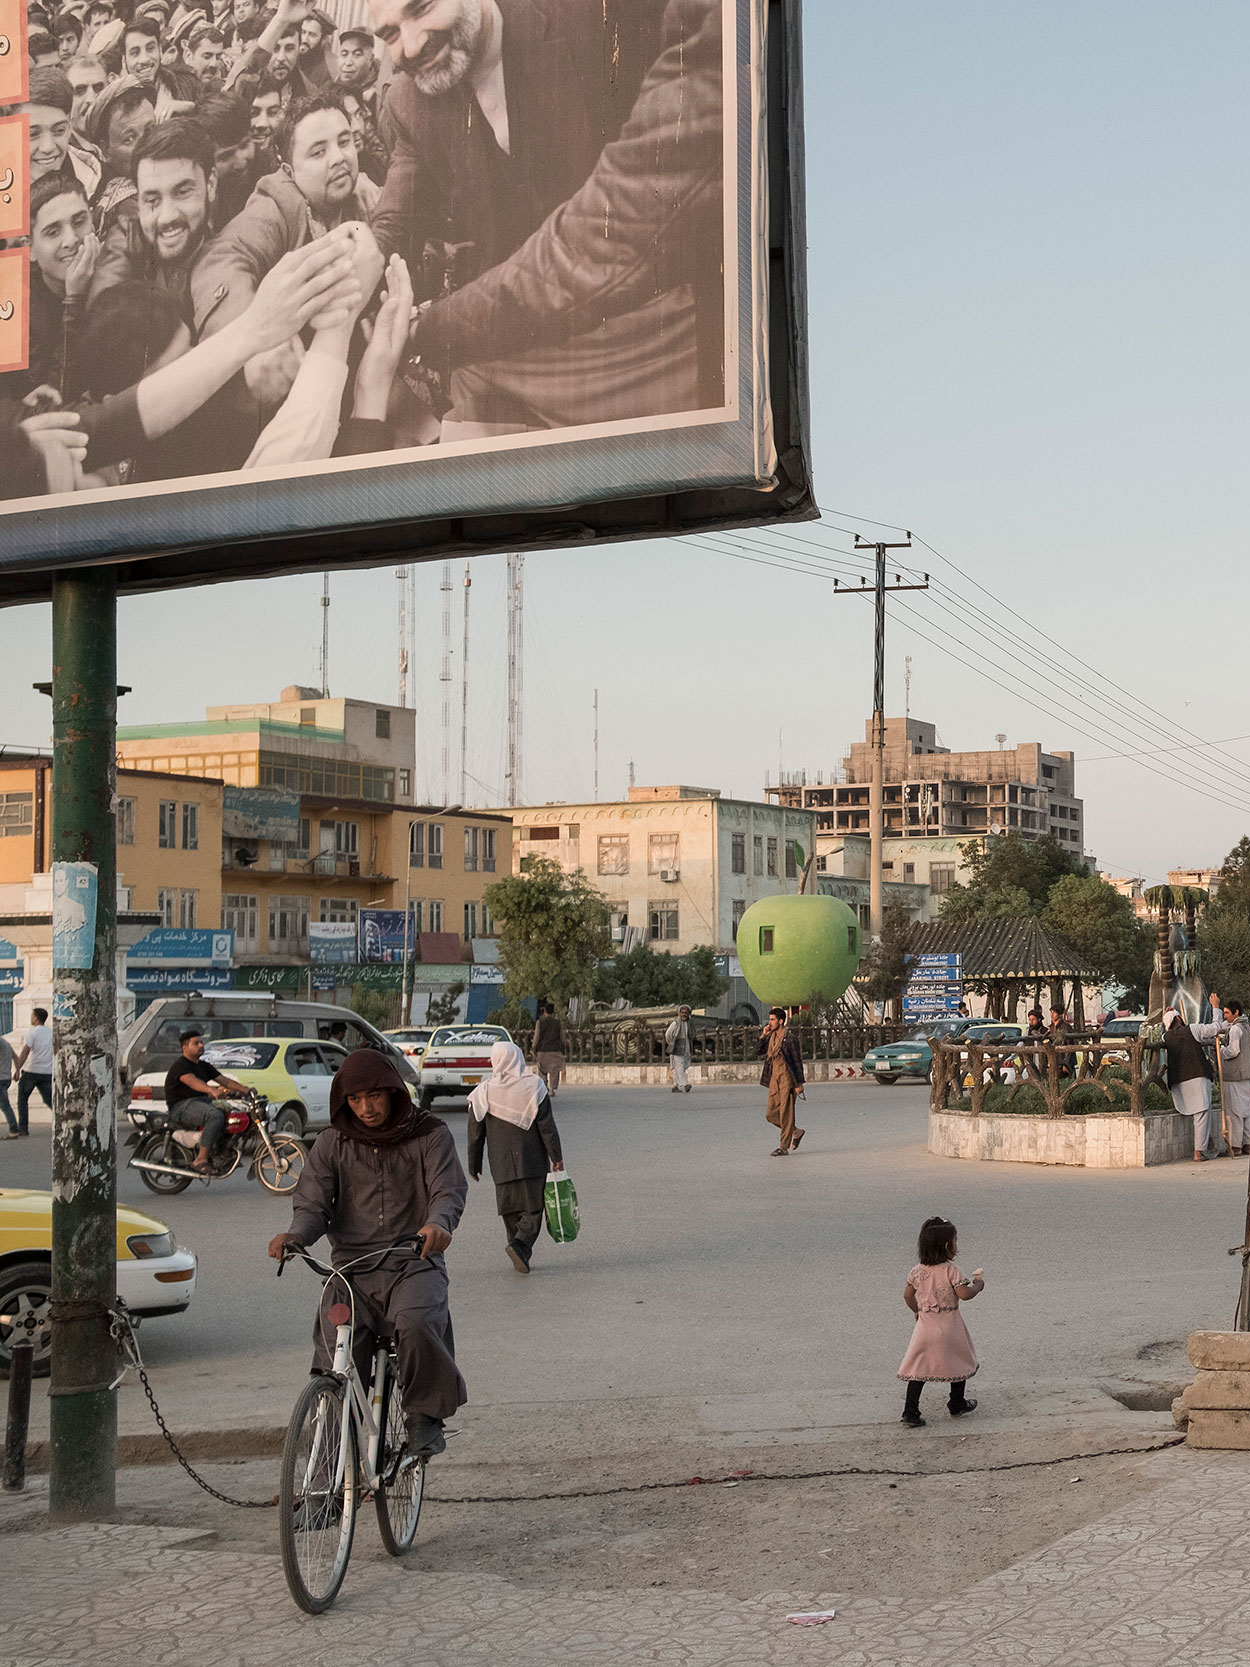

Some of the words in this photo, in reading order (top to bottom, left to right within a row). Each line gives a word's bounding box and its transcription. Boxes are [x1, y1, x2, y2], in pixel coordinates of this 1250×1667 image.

[189, 932, 207, 943] مرکز
[126, 971, 159, 988] تعمی
[181, 970, 231, 987] فروشگاه
